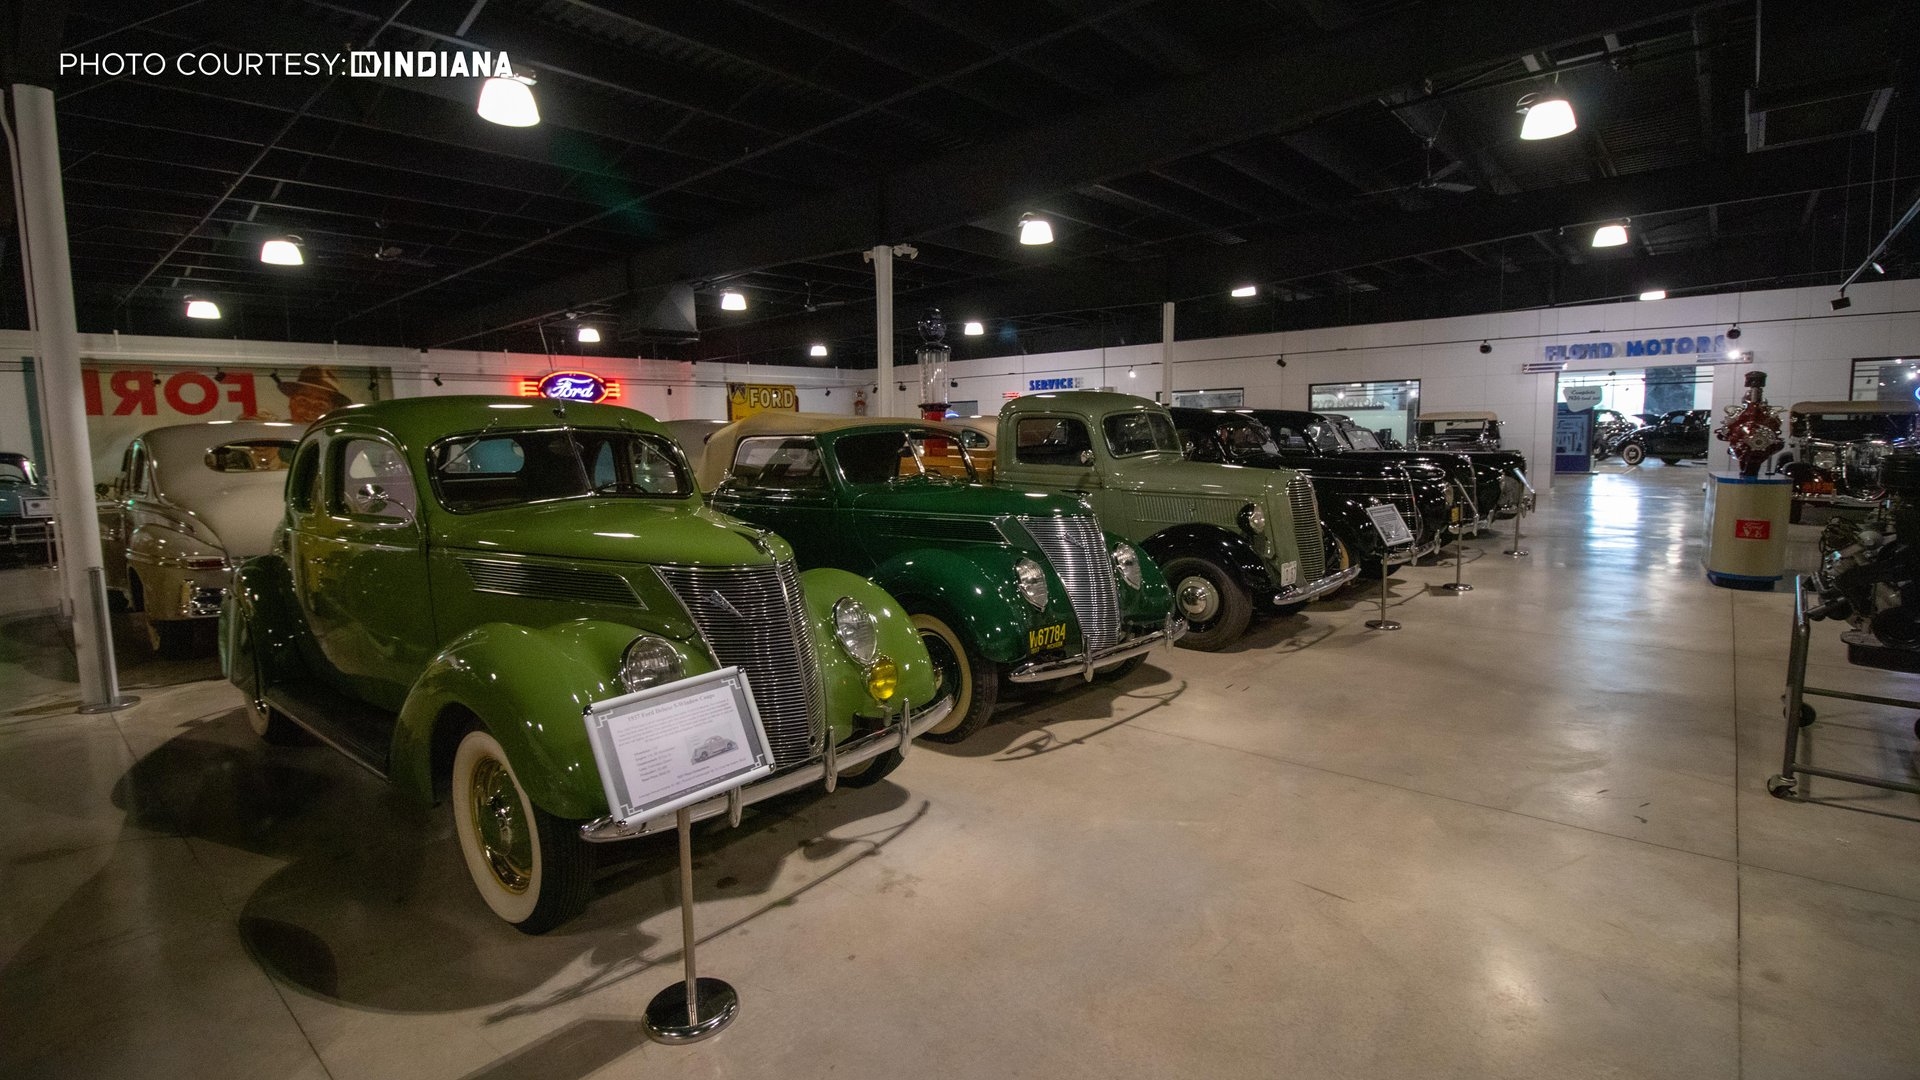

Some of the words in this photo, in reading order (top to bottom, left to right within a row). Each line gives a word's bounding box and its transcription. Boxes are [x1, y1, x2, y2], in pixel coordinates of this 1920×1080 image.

[1626, 335, 1725, 357] MOTORS
[548, 377, 595, 398] Ford
[1029, 377, 1074, 391] SERVICE
[749, 387, 794, 408] FORD
[641, 710, 654, 718] Ford
